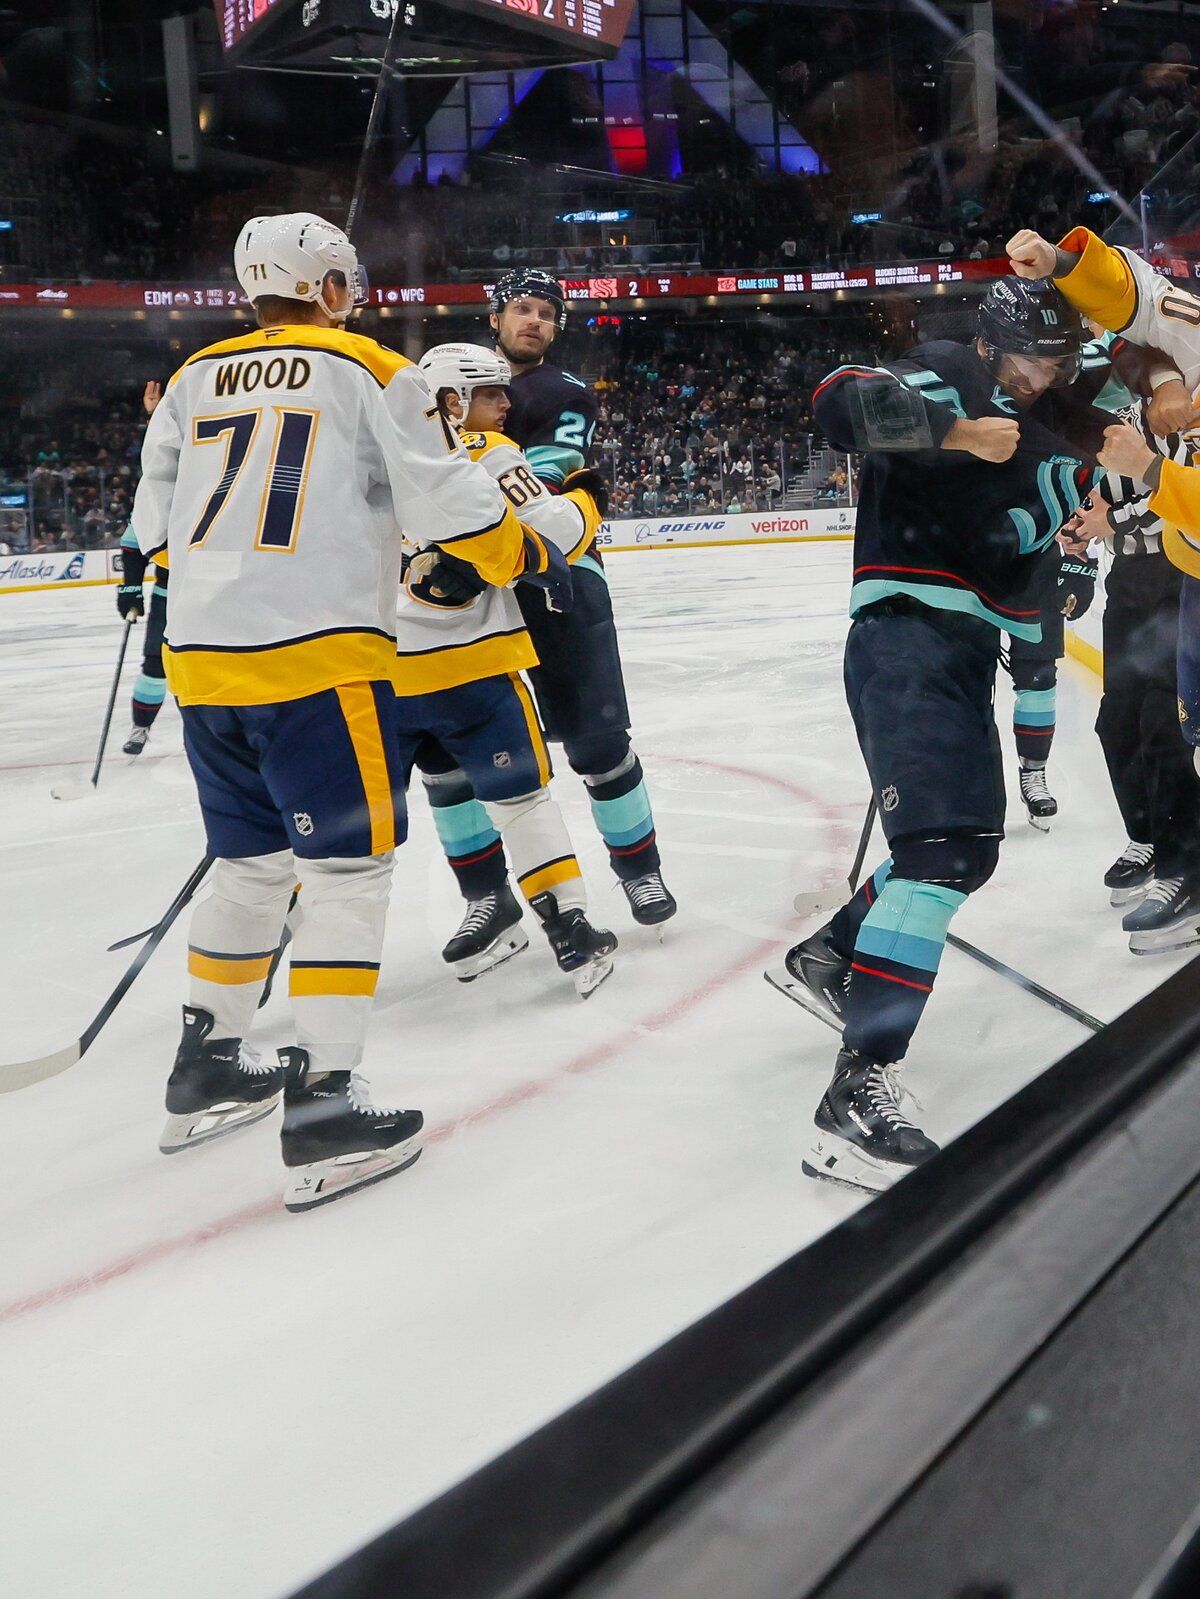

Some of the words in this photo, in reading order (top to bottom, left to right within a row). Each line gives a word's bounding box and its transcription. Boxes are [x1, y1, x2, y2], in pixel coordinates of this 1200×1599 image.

[249, 263, 268, 281] 71
[628, 281, 638, 296] 2
[737, 279, 757, 289] GAME
[757, 278, 778, 289] STATS
[144, 291, 172, 305] EDM
[194, 291, 203, 305] 3
[227, 290, 237, 305] 2
[376, 289, 382, 303] 1
[400, 288, 425, 302] WPG
[995, 280, 1018, 304] amazon
[1040, 309, 1058, 325] 10
[214, 357, 311, 397] WOOD
[187, 405, 321, 554] 71
[500, 465, 543, 508] 68
[658, 521, 726, 533] BOEING
[751, 517, 809, 534] verizon
[0, 560, 55, 580] Alaska
